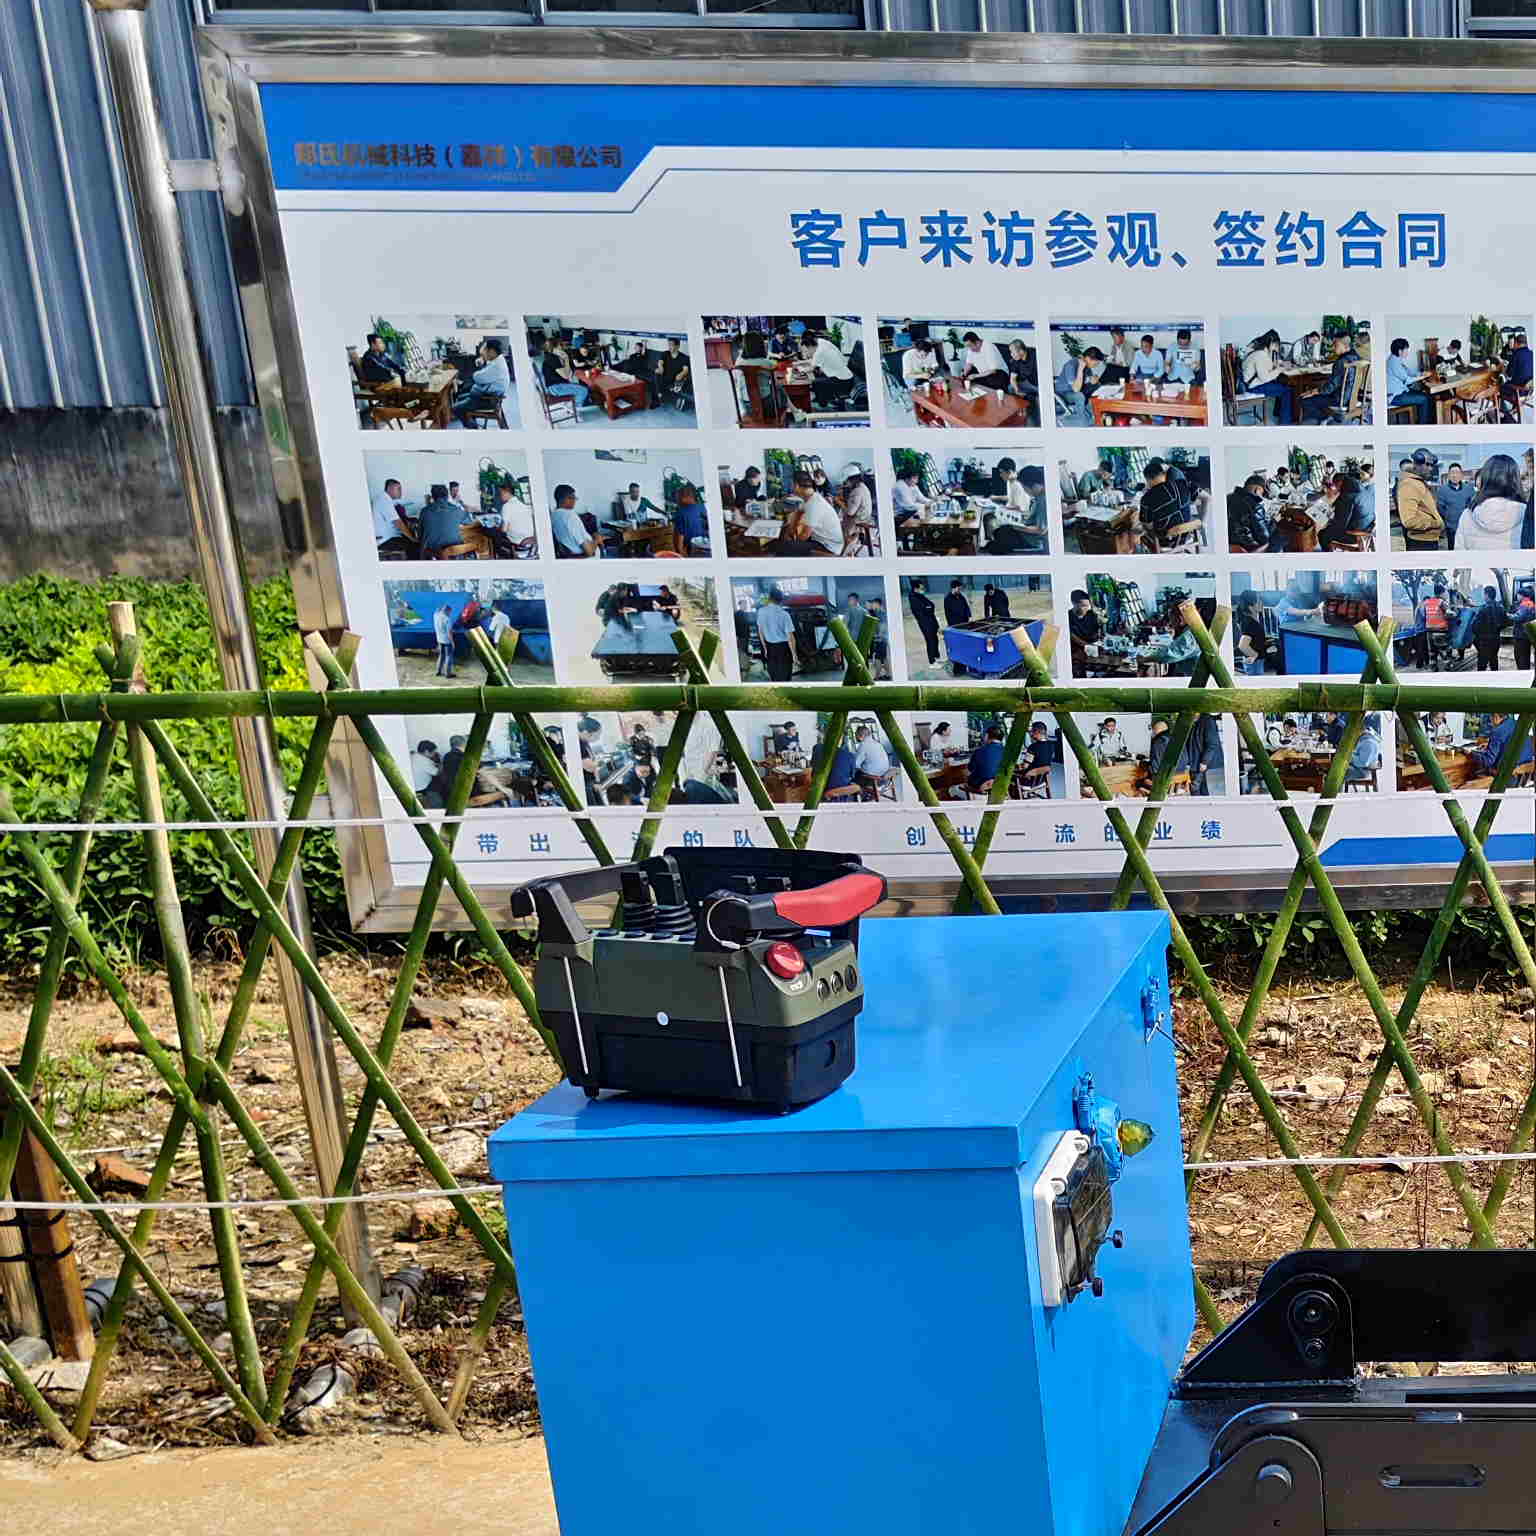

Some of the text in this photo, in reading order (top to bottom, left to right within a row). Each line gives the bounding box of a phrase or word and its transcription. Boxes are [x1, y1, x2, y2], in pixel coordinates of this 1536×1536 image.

[790, 208, 1447, 268] 客户来访参观、签约合同
